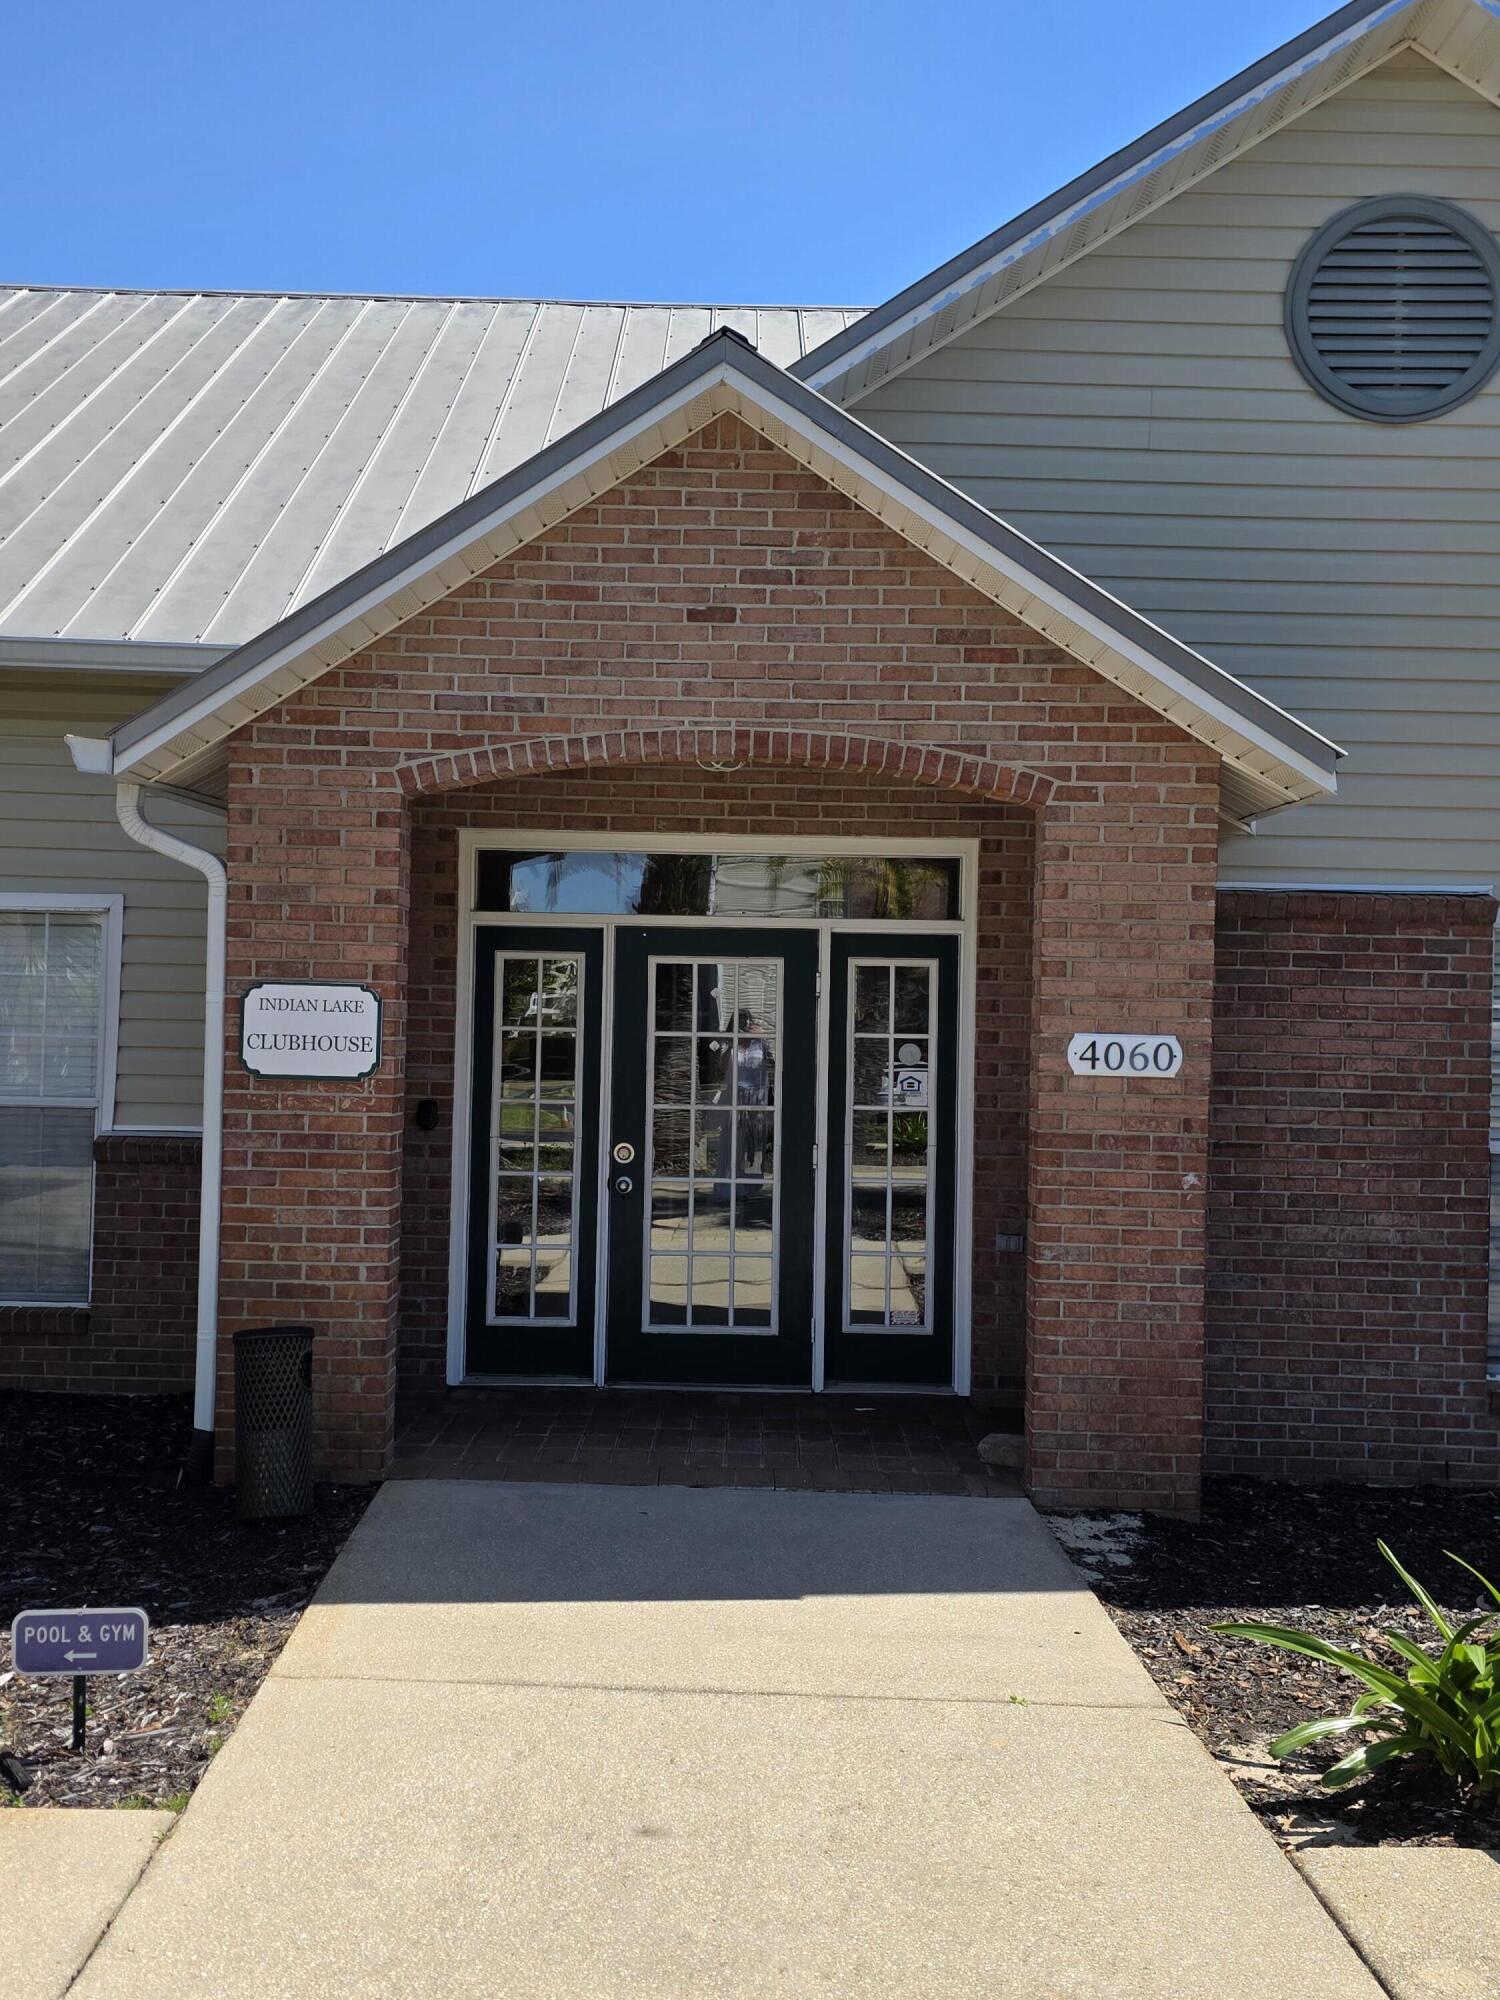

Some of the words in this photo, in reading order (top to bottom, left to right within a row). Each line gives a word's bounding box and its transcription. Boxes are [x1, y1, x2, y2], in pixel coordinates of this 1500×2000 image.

[258, 997, 318, 1012] INDIAN
[322, 999, 365, 1013] LAKE
[247, 1033, 373, 1052] CLUBHOUSE
[1079, 1040, 1174, 1071] 4060
[24, 1626, 71, 1644] POOL
[78, 1625, 93, 1643] &
[100, 1624, 136, 1642] GYM
